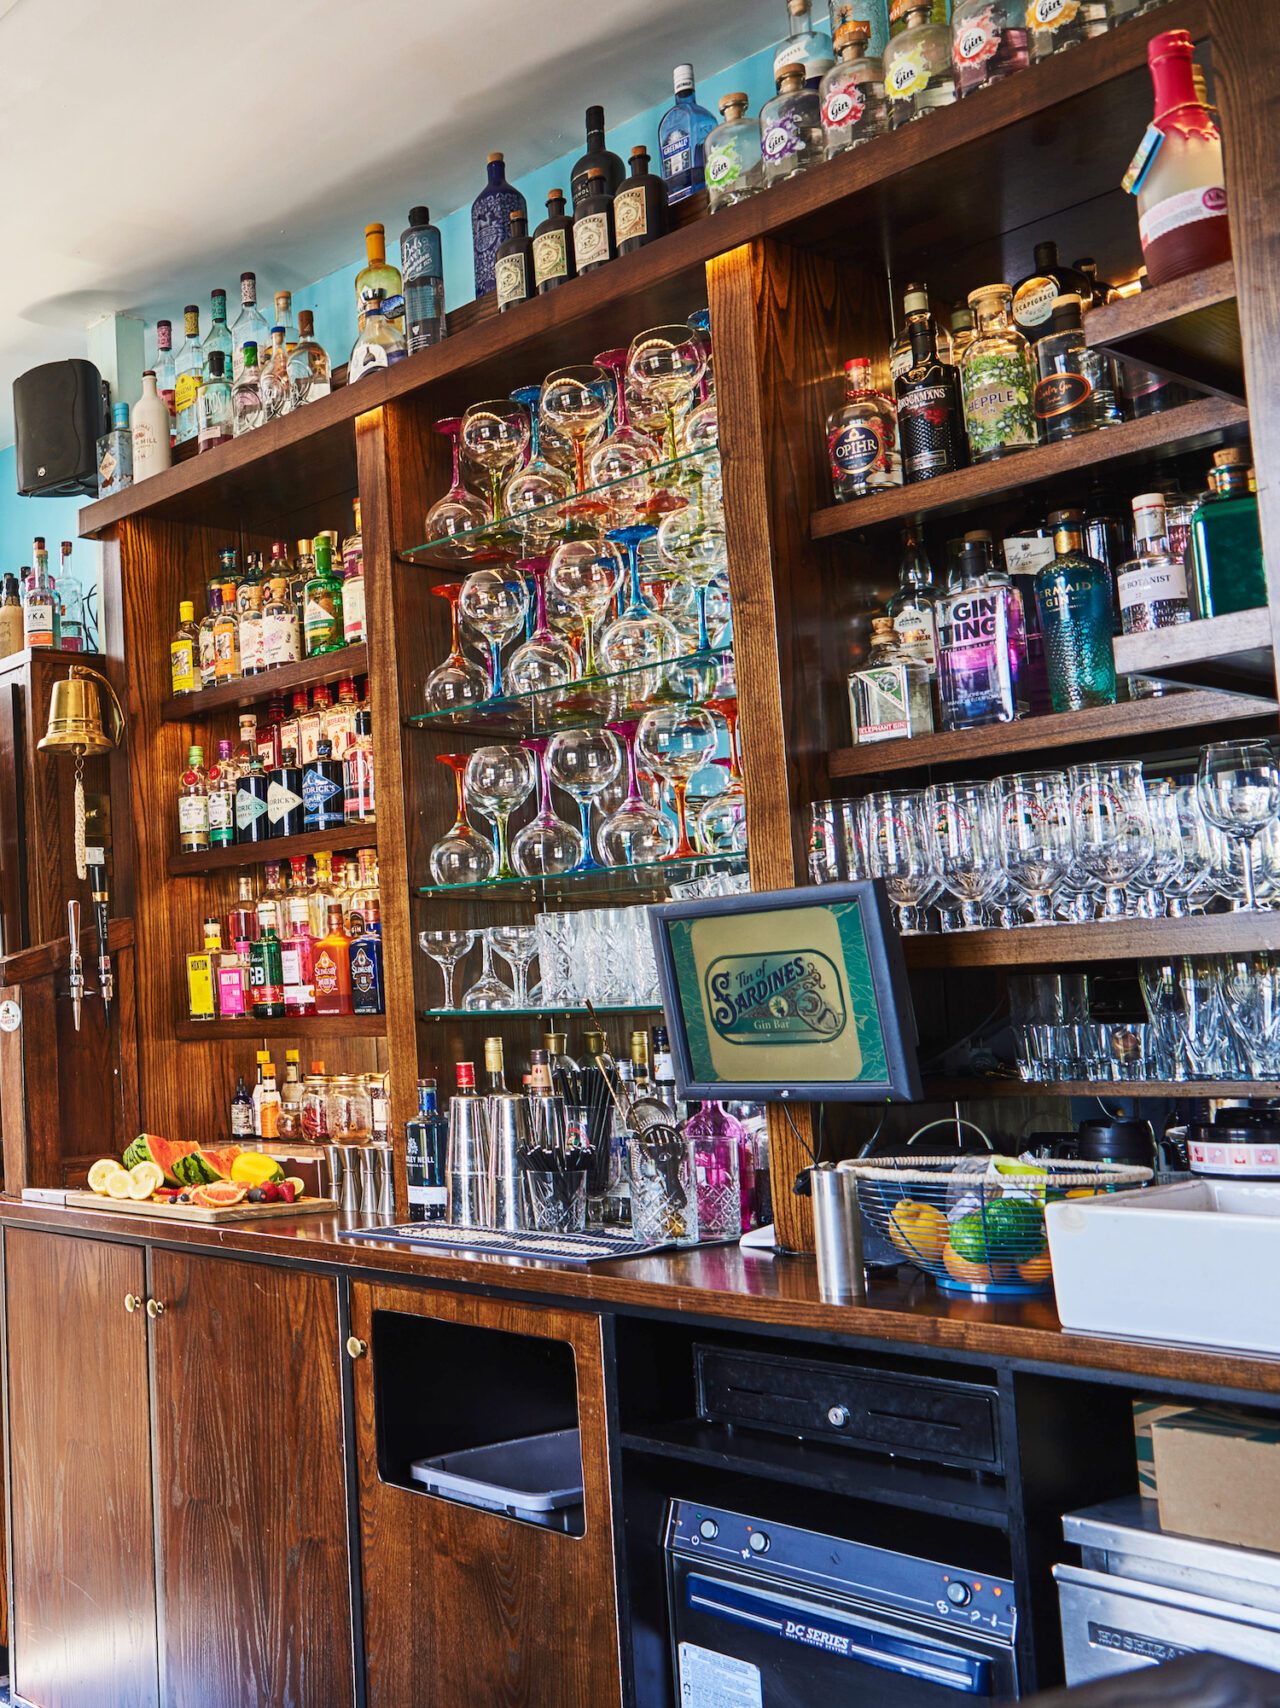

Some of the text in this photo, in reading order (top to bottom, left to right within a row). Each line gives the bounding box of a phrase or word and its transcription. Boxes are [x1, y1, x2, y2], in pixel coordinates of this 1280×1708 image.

[962, 35, 984, 54] Gin
[895, 69, 914, 88] Gin
[831, 101, 849, 118] Gin
[768, 133, 786, 150] Gin
[712, 160, 728, 178] Gin
[1015, 291, 1055, 313] SCAPEGRACE
[835, 439, 878, 458] OPIHR
[1039, 581, 1092, 599] ERMAID
[1127, 574, 1172, 589] BOTANIST
[952, 595, 997, 622] GIN
[938, 616, 997, 646] TING
[860, 721, 906, 735] ELEPHANT GIN
[303, 784, 336, 794] NDRICK'S
[270, 797, 296, 806] DRICK'S
[735, 958, 768, 989] Tin of
[711, 956, 806, 1027] SARDINES
[753, 1018, 791, 1031] Gin Bar
[417, 1156, 435, 1164] NEILL
[785, 1620, 850, 1650] DC SERIES
[1097, 1630, 1185, 1662] HOSHIZA
